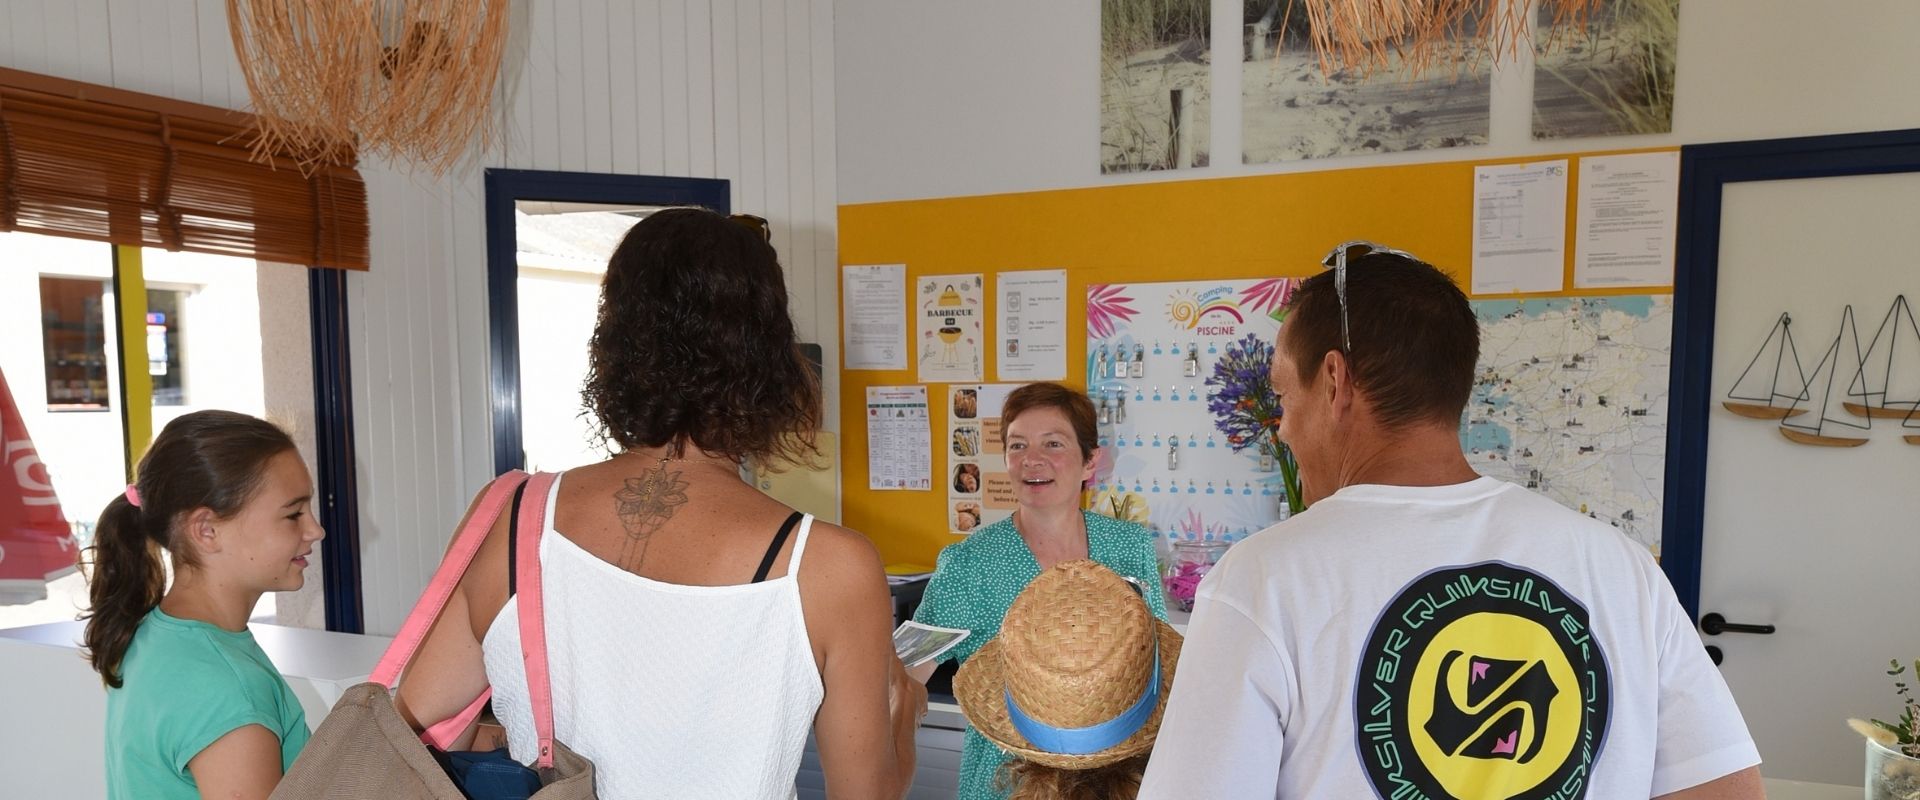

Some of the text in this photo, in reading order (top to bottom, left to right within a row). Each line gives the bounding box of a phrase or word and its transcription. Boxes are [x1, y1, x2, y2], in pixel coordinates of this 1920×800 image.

[1197, 287, 1233, 302] Camping
[927, 308, 973, 317] BARBECUE
[1197, 326, 1235, 336] PISCINE
